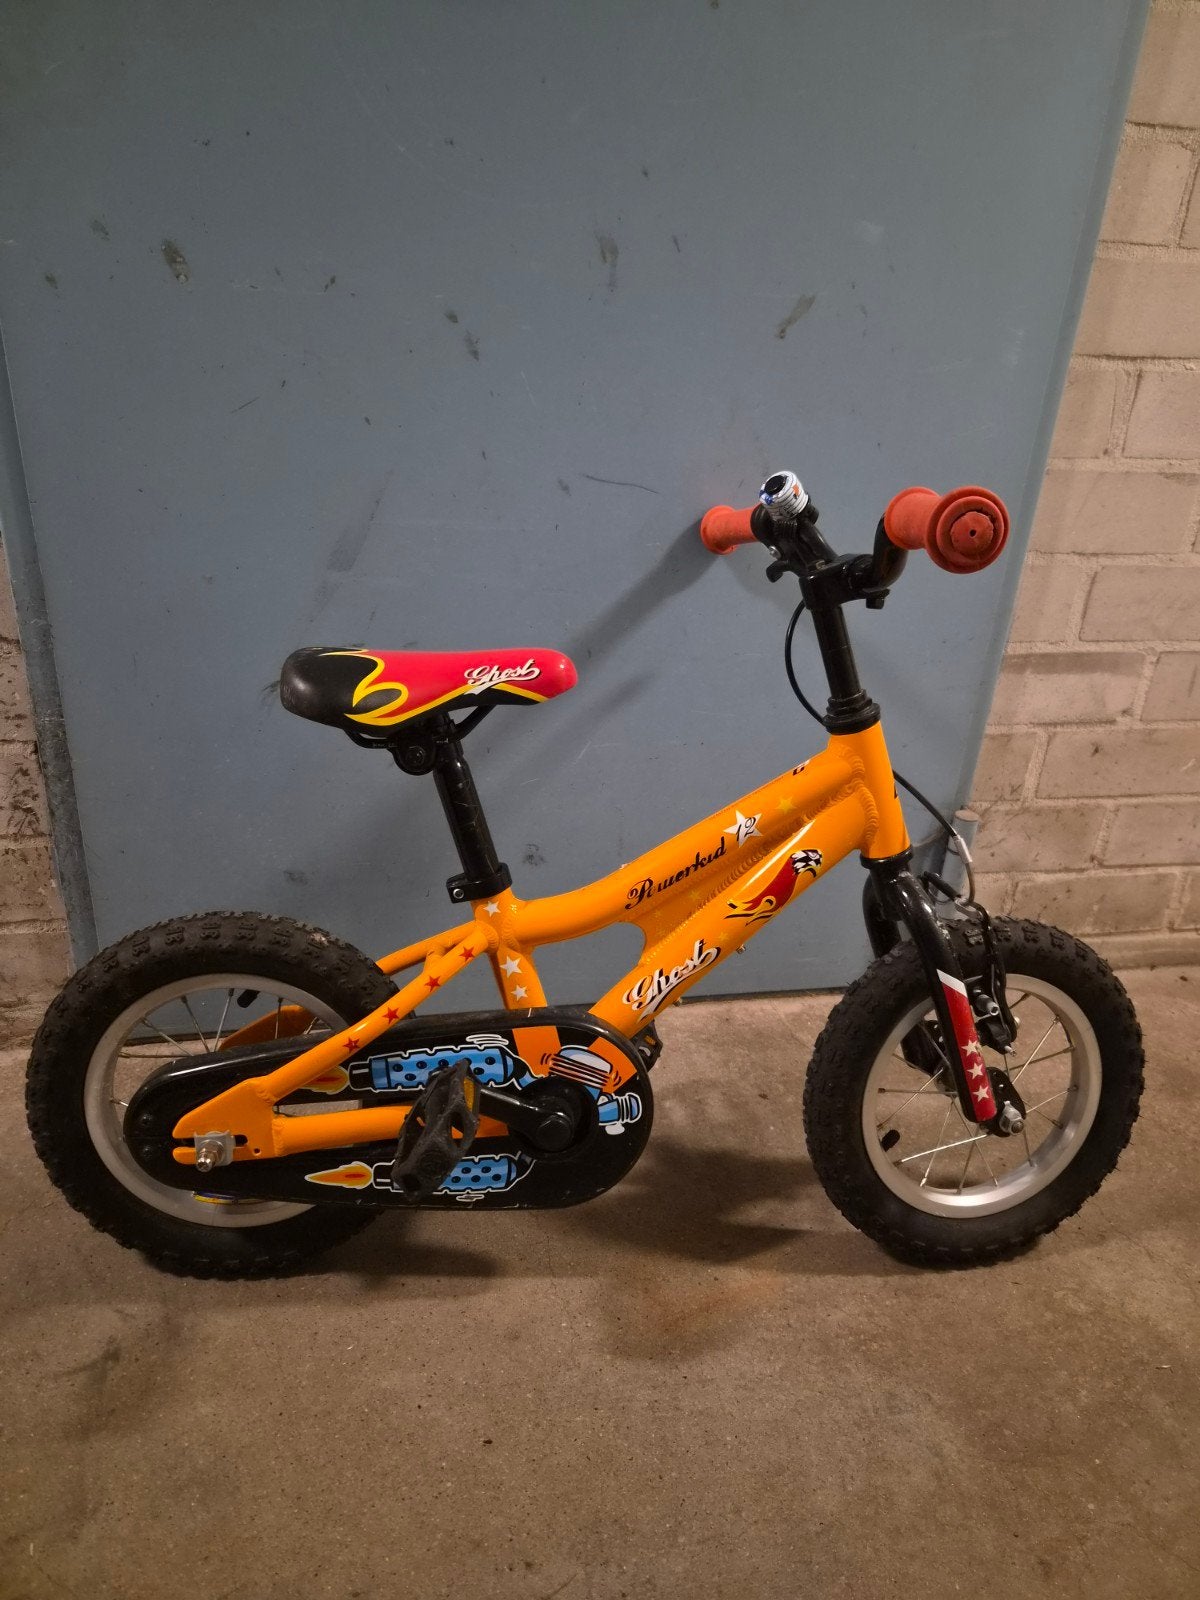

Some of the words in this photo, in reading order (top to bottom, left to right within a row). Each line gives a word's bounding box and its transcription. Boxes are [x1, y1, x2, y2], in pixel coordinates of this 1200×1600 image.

[464, 659, 541, 695] Ghost
[736, 817, 757, 842] 12
[622, 939, 721, 1023] Ghost
